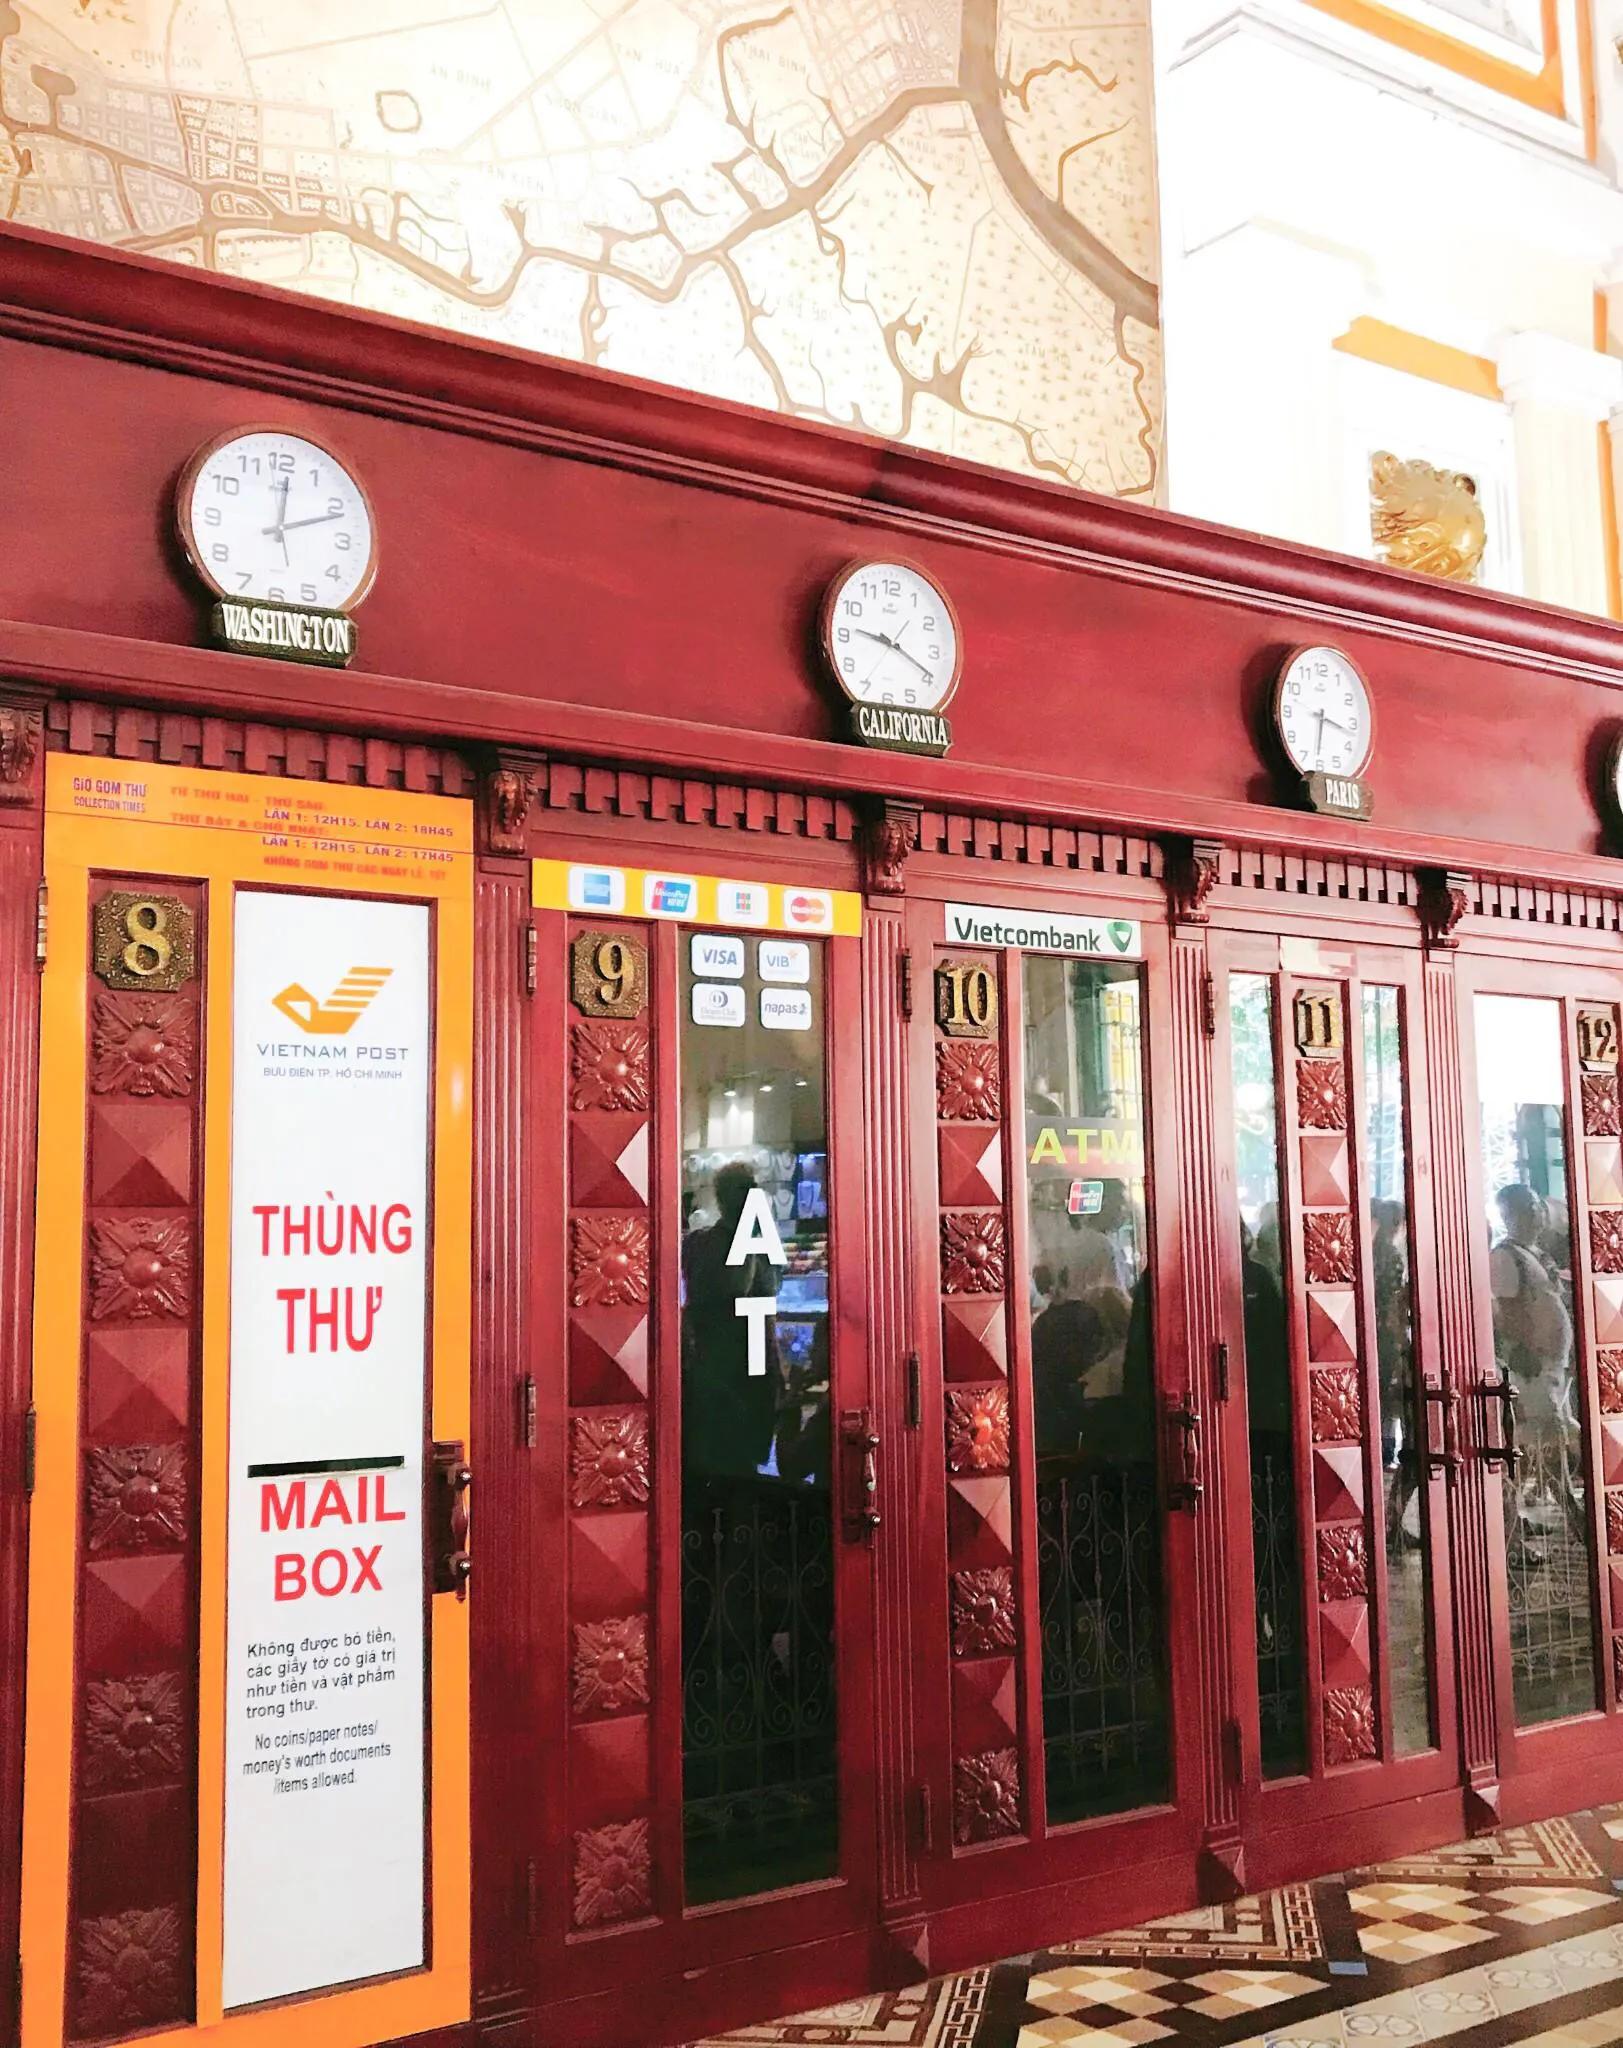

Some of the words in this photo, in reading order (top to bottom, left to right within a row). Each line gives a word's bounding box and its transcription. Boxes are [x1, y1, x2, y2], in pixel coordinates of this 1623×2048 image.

[237, 455, 261, 475] 11
[267, 452, 295, 474] 12
[211, 474, 240, 496] 10
[309, 469, 319, 487] 1
[327, 497, 344, 517] 2
[204, 507, 222, 527] 9
[334, 532, 351, 551] 3
[212, 543, 229, 562] 8
[235, 572, 252, 590] 7
[324, 564, 342, 583] 4
[301, 584, 318, 602] 5
[860, 582, 877, 600] 11
[881, 579, 901, 597] 12
[843, 600, 863, 618] 10
[910, 592, 918, 608] 1
[221, 603, 351, 654] WASHINGTON
[923, 616, 936, 632] 2
[838, 627, 851, 644] 9
[928, 644, 940, 660] 3
[843, 657, 856, 674] 8
[1298, 666, 1312, 681] 11
[1314, 663, 1329, 678] 12
[859, 679, 872, 695] 7
[921, 672, 934, 687] 4
[1286, 681, 1301, 696] 10
[1333, 674, 1341, 687] 1
[904, 689, 917, 704] 5
[1344, 693, 1354, 706] 2
[1283, 705, 1292, 718] 9
[859, 706, 949, 746] CALIFORNIA
[1349, 717, 1358, 730] 3
[1287, 730, 1296, 744] 8
[1344, 740, 1352, 752] 4
[1299, 750, 1309, 762] 7
[1332, 756, 1342, 769] 5
[96, 779, 121, 795] GOM
[1325, 778, 1360, 810] PARIS
[74, 795, 120, 811] COLLECTION
[122, 801, 145, 813] TIMES
[412, 825, 454, 837] 18H45
[412, 851, 454, 862] 17H45
[122, 902, 172, 976] 8
[954, 917, 1101, 952] Vietcombank
[703, 948, 738, 965] VISA
[766, 954, 790, 967] VIB
[597, 941, 635, 1005] 9
[946, 967, 992, 1027] 10
[764, 1002, 798, 1016] napas
[1299, 996, 1340, 1048] 11
[1580, 1015, 1617, 1064] 12
[256, 1043, 347, 1058] VIETNAM
[356, 1047, 409, 1060] POST
[375, 1070, 403, 1080] MINH
[1030, 1127, 1138, 1164] ATM
[252, 1190, 412, 1256] THÙNG
[276, 1286, 383, 1354] THƯ
[260, 1475, 406, 1532] MAIL
[274, 1544, 383, 1602] BOX
[247, 1641, 295, 1658] Không
[247, 1662, 272, 1679] các
[356, 1649, 376, 1668] giá
[247, 1683, 276, 1698] như
[332, 1672, 353, 1690] vật
[246, 1703, 285, 1719] trong
[255, 1733, 271, 1750] No
[274, 1726, 341, 1748] coins/paper
[344, 1720, 379, 1738] notes/
[242, 1754, 292, 1775] money's
[295, 1750, 327, 1769] worth
[329, 1743, 392, 1764] documents
